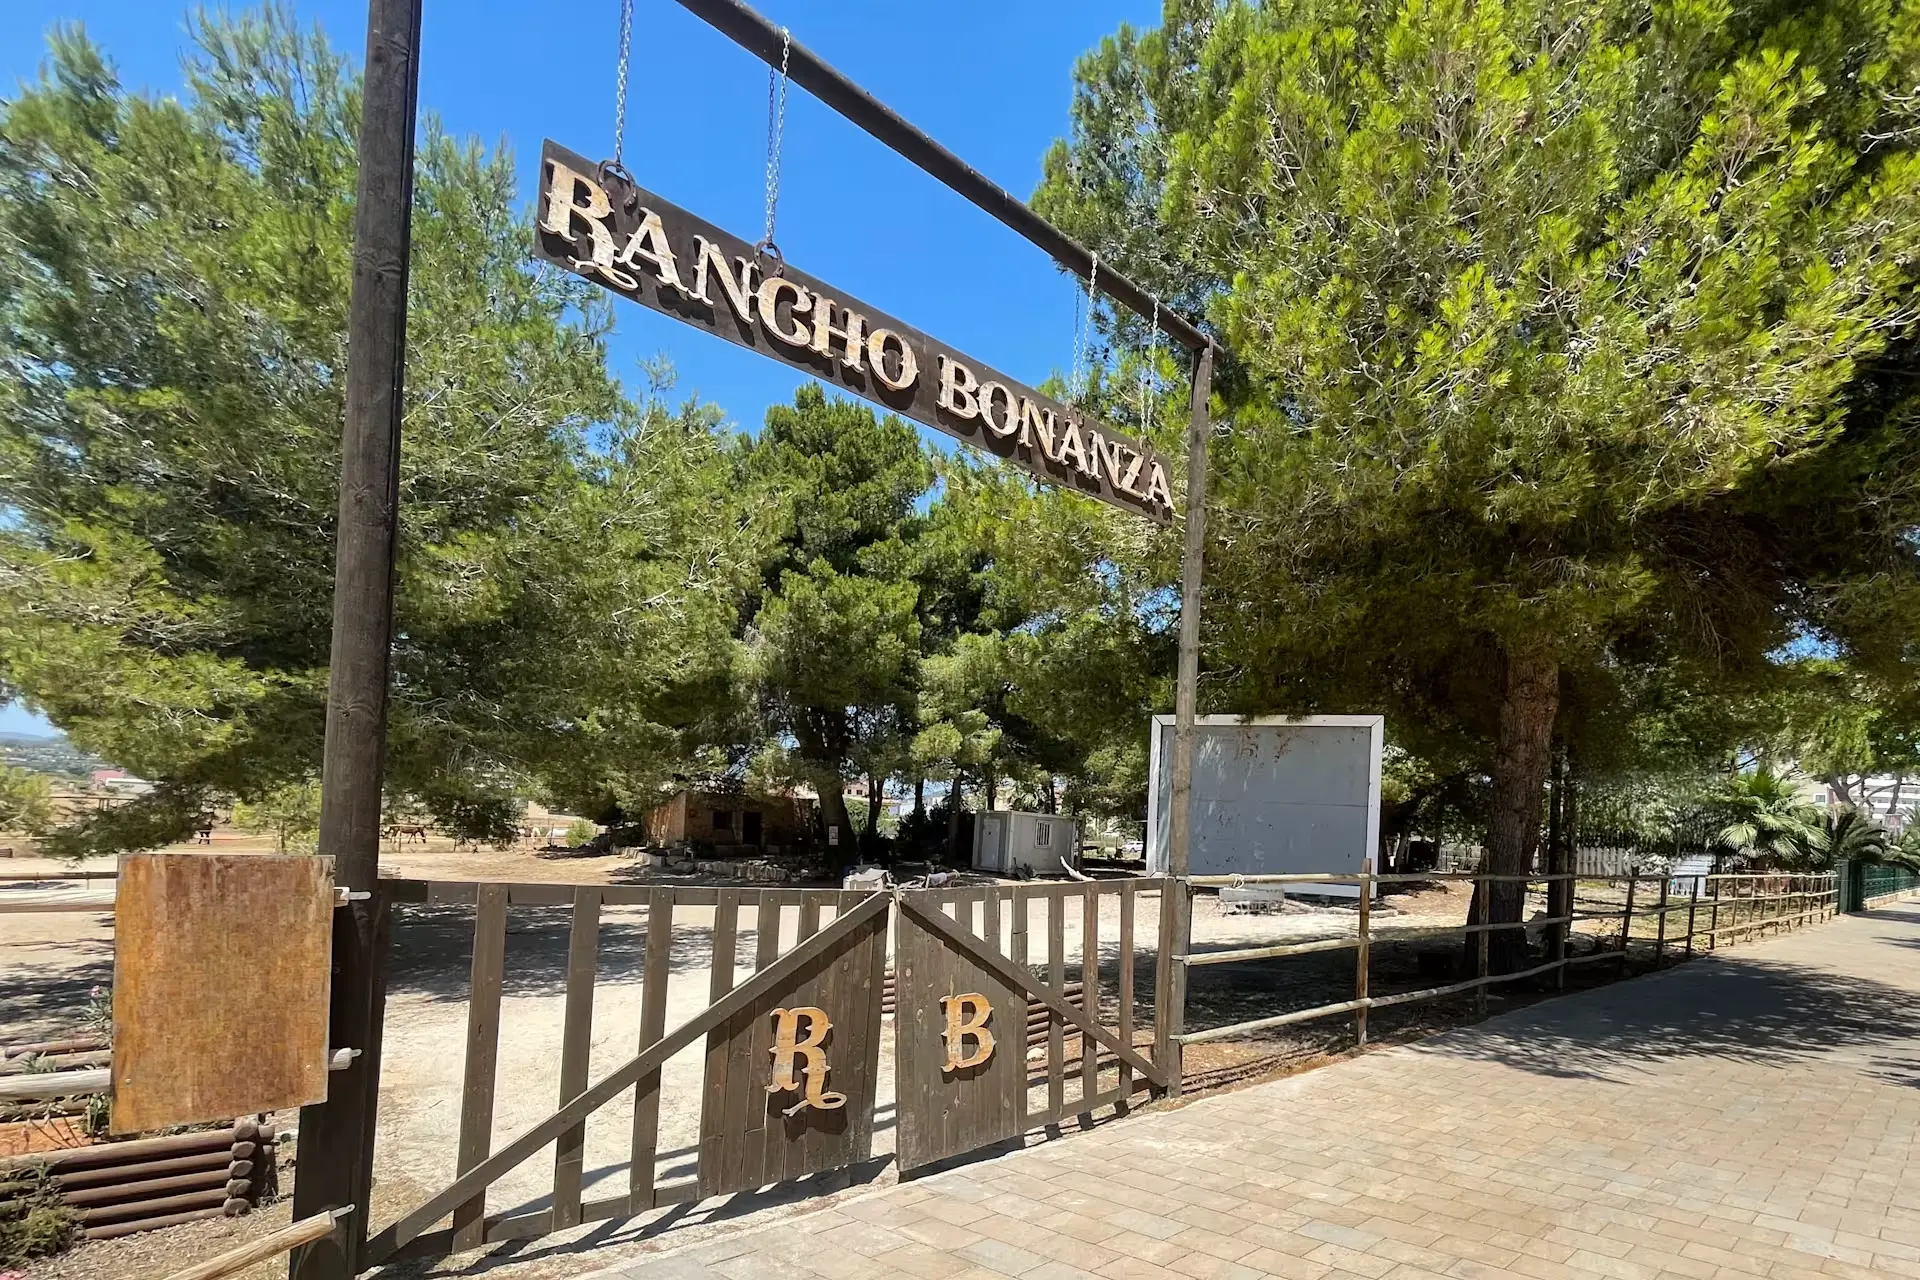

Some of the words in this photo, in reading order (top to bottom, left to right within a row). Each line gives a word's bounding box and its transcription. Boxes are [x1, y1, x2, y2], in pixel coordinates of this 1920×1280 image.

[539, 157, 920, 392] RANCHO
[936, 353, 1176, 512] BONANZA
[764, 1006, 847, 1117] R
[939, 992, 997, 1072] B
